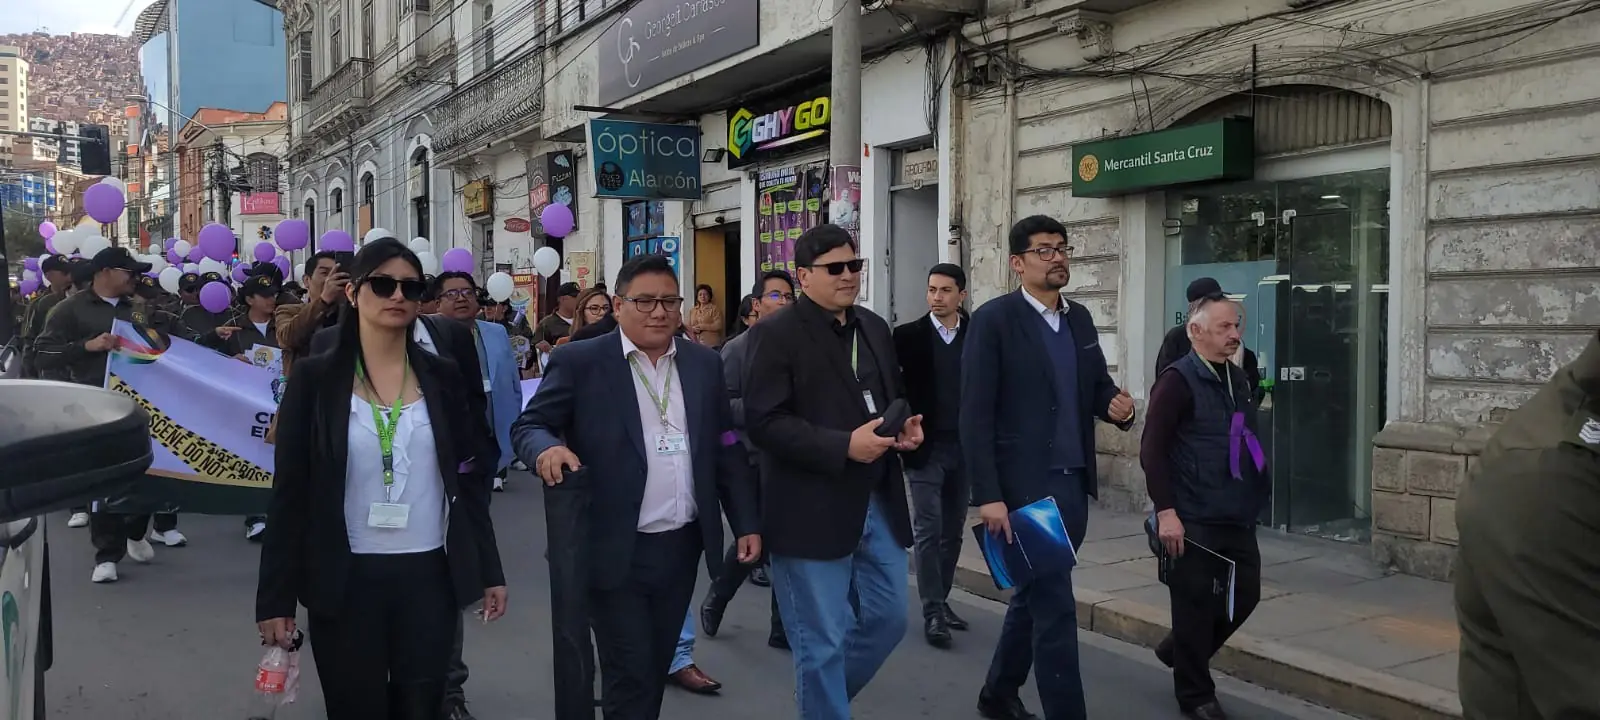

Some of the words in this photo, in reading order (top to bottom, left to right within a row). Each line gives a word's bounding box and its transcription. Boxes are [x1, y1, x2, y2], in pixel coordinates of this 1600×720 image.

[752, 106, 796, 143] GHY
[597, 127, 695, 160] óptica
[1104, 151, 1151, 172] Mercantil
[1154, 149, 1185, 164] Santa
[1187, 145, 1213, 159] Cruz
[629, 168, 697, 189] Alarcón
[149, 413, 186, 450] SCENE
[183, 441, 204, 463] DO
[199, 456, 230, 478] NOT
